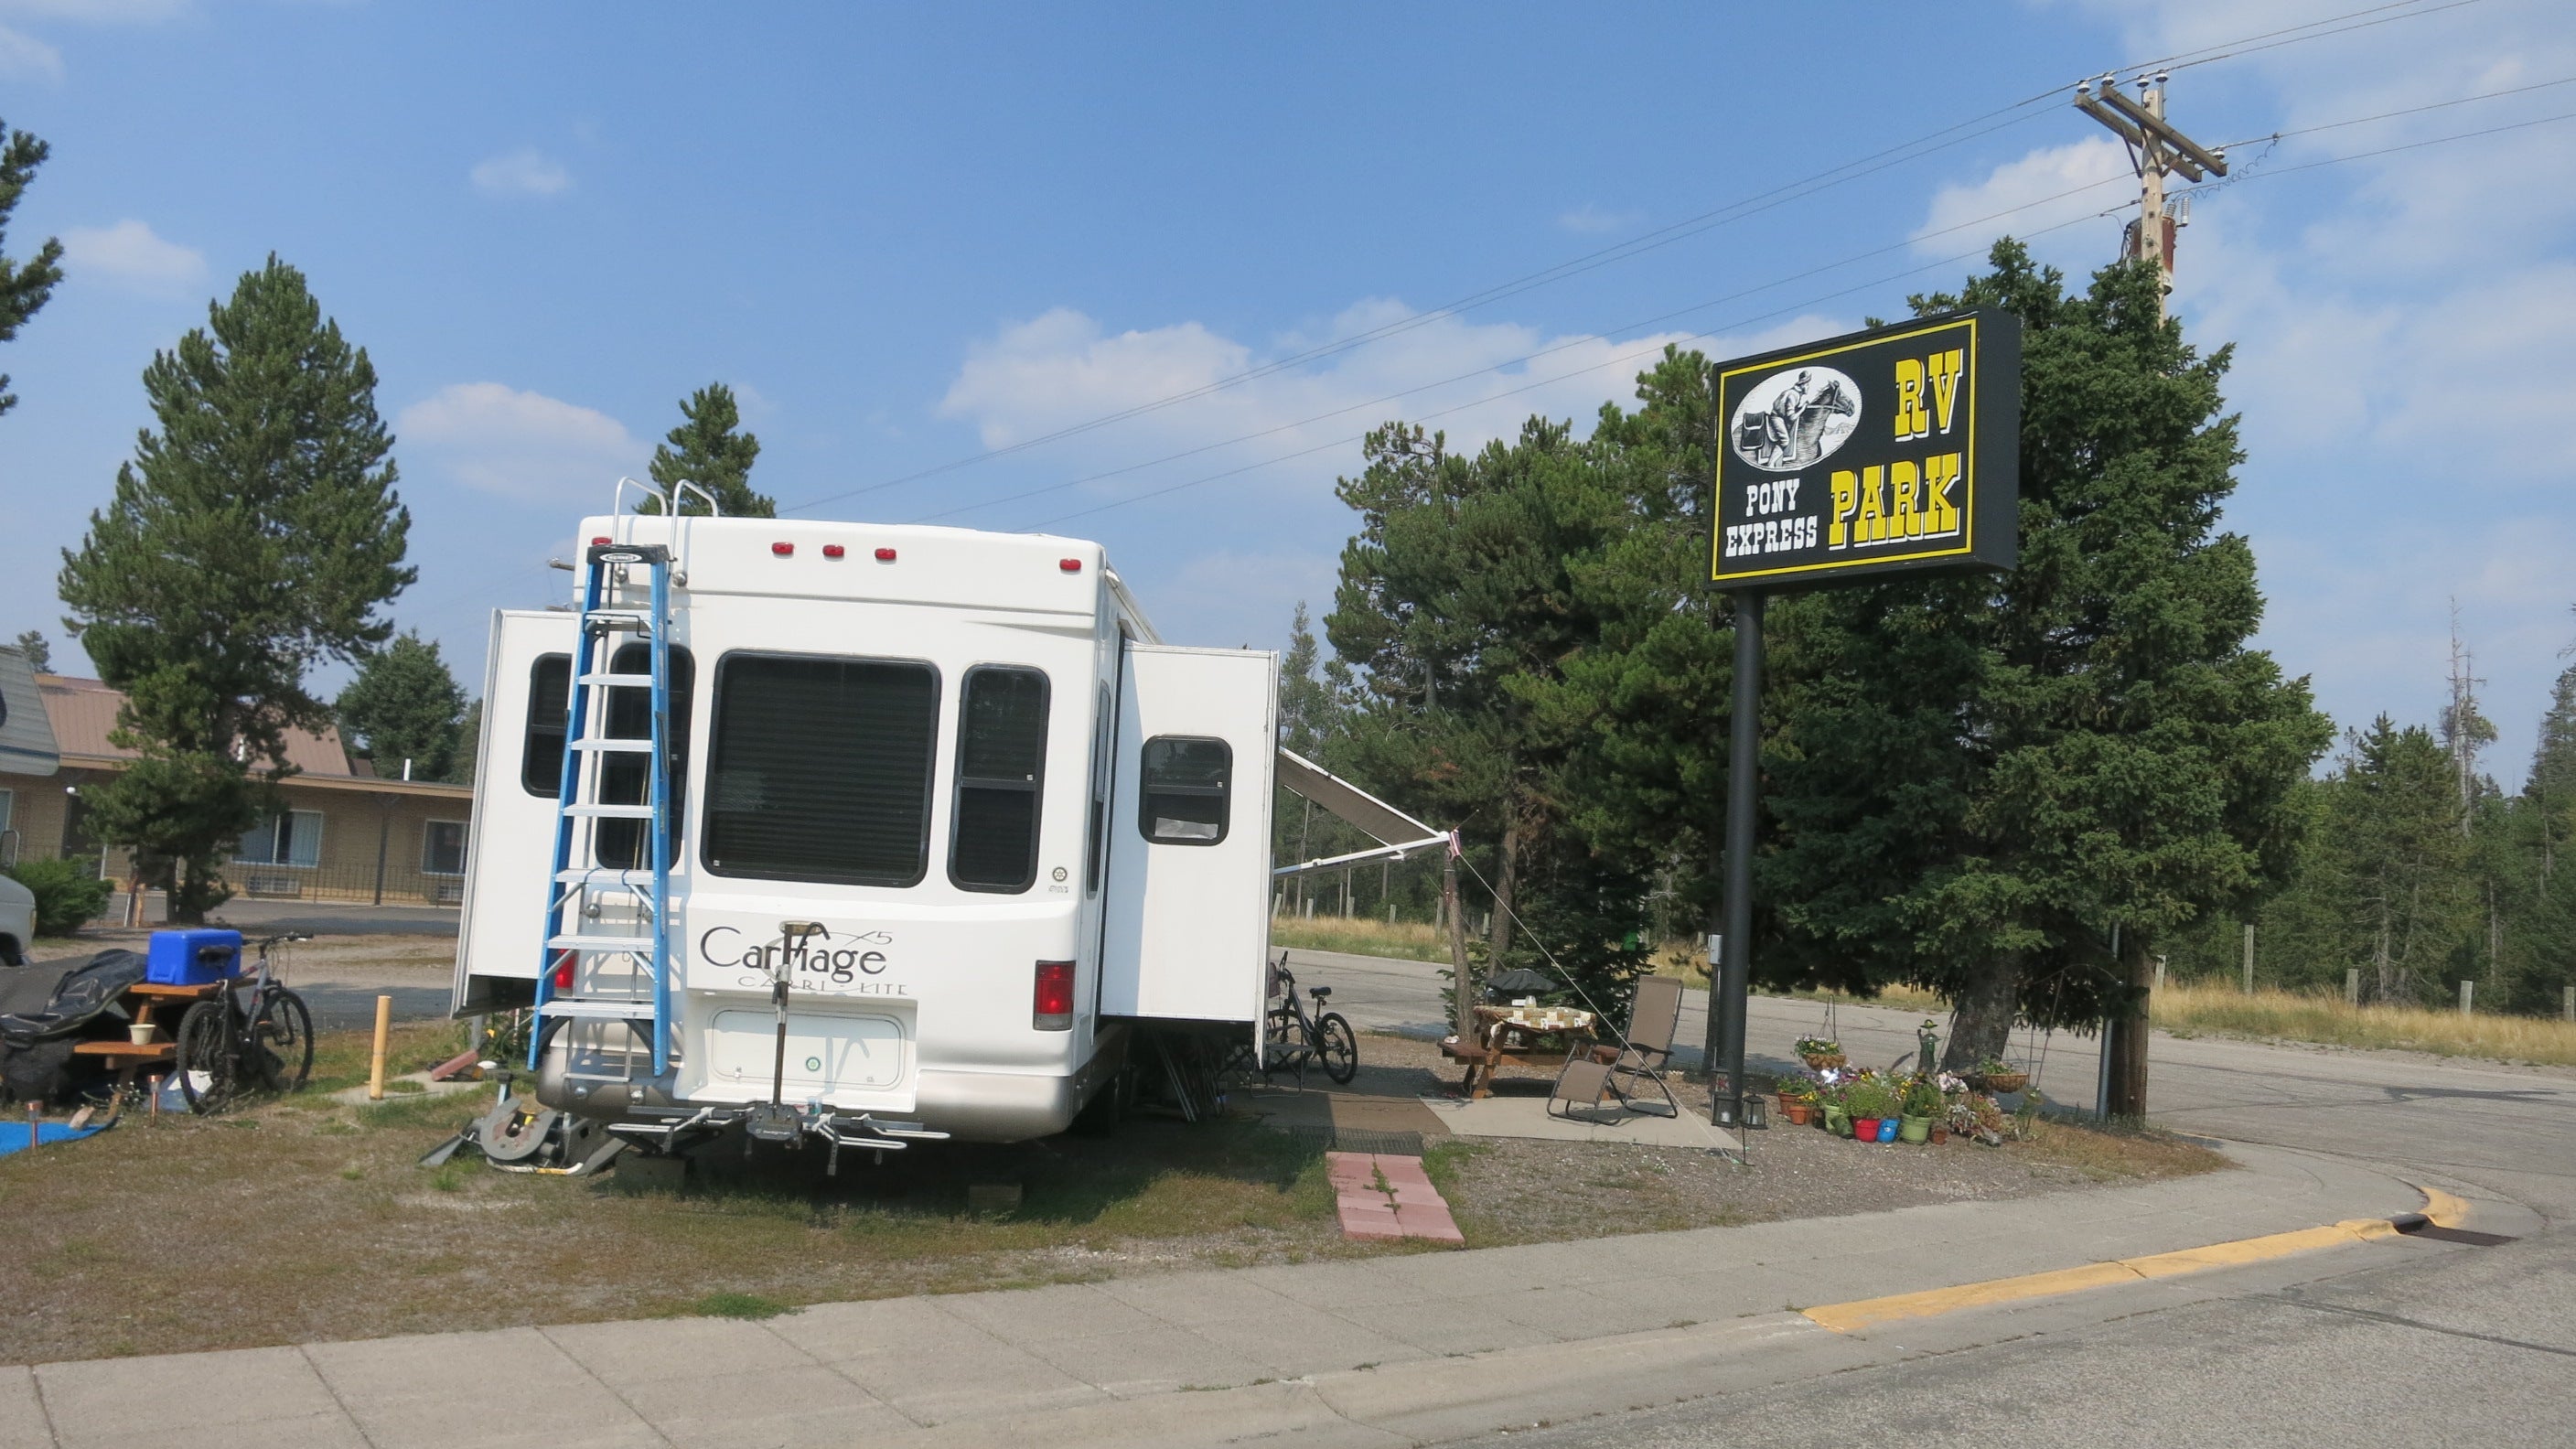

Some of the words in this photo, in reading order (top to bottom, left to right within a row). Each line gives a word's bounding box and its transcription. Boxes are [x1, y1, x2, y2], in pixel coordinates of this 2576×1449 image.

[1894, 349, 1964, 443] RV
[1745, 478, 1800, 517] PONY
[1828, 452, 1961, 551] PARK
[1724, 515, 1819, 558] EXPRESS
[700, 926, 887, 983] Cariage
[860, 982, 908, 996] LITE
